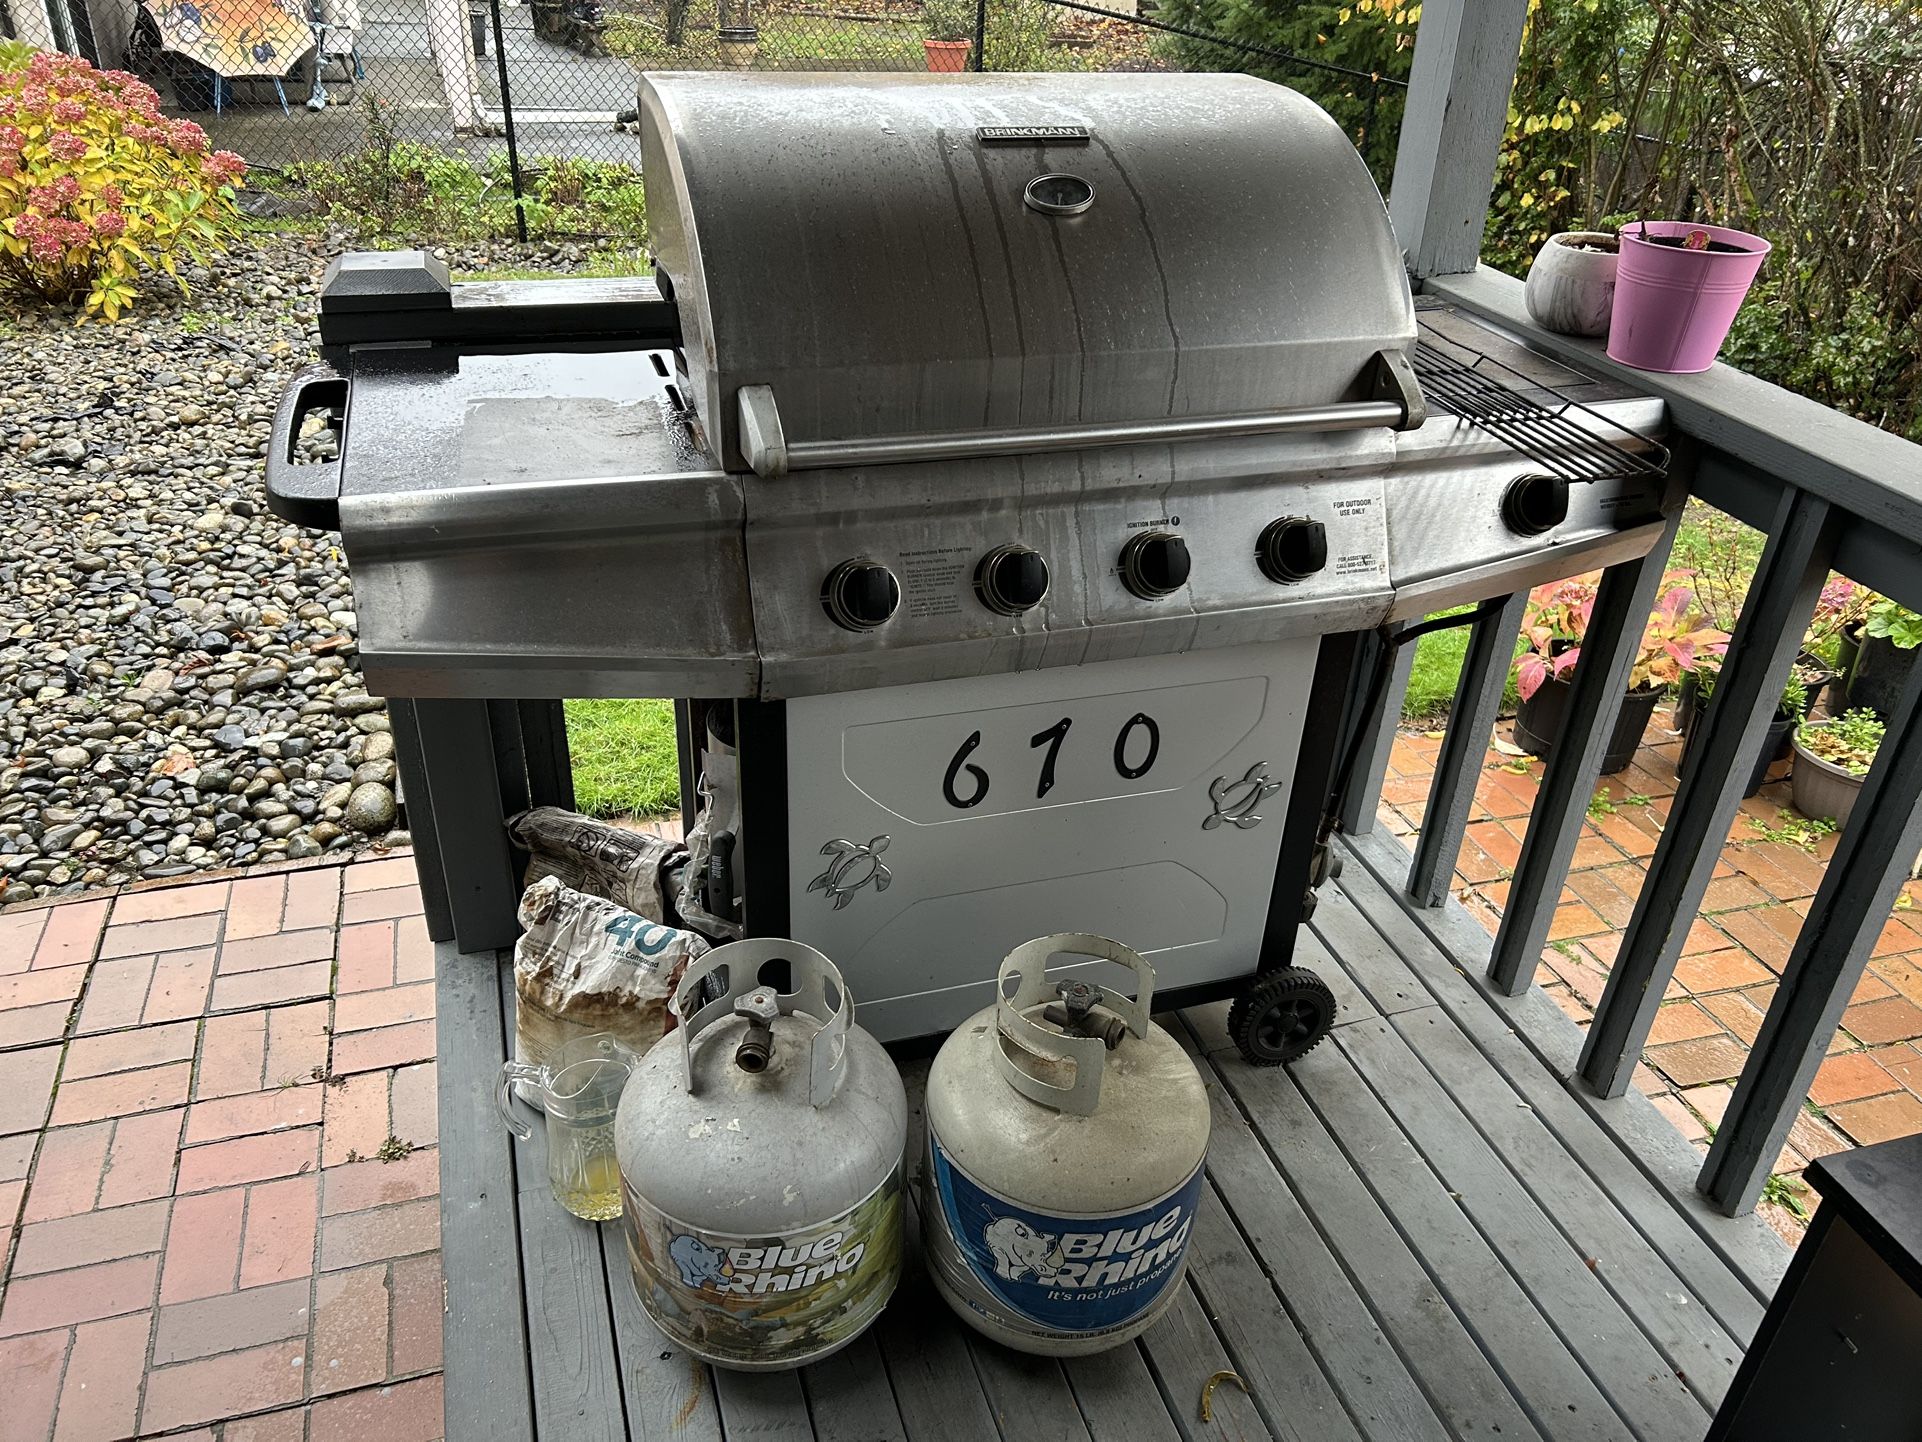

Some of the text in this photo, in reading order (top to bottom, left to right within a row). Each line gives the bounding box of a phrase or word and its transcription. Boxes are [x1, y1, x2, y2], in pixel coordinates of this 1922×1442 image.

[1333, 499, 1372, 509] FOR OUTDOOR
[1339, 507, 1366, 516] USE ONLY
[1059, 1206, 1181, 1258] Blue
[727, 1231, 843, 1270] Blue
[1037, 1215, 1192, 1288] Rhino
[715, 1242, 865, 1294] Rhino
[1047, 1290, 1073, 1301] It's
[1076, 1290, 1104, 1301] not
[1104, 1281, 1134, 1299] just
[1046, 1332, 1074, 1340] WEIGHT
